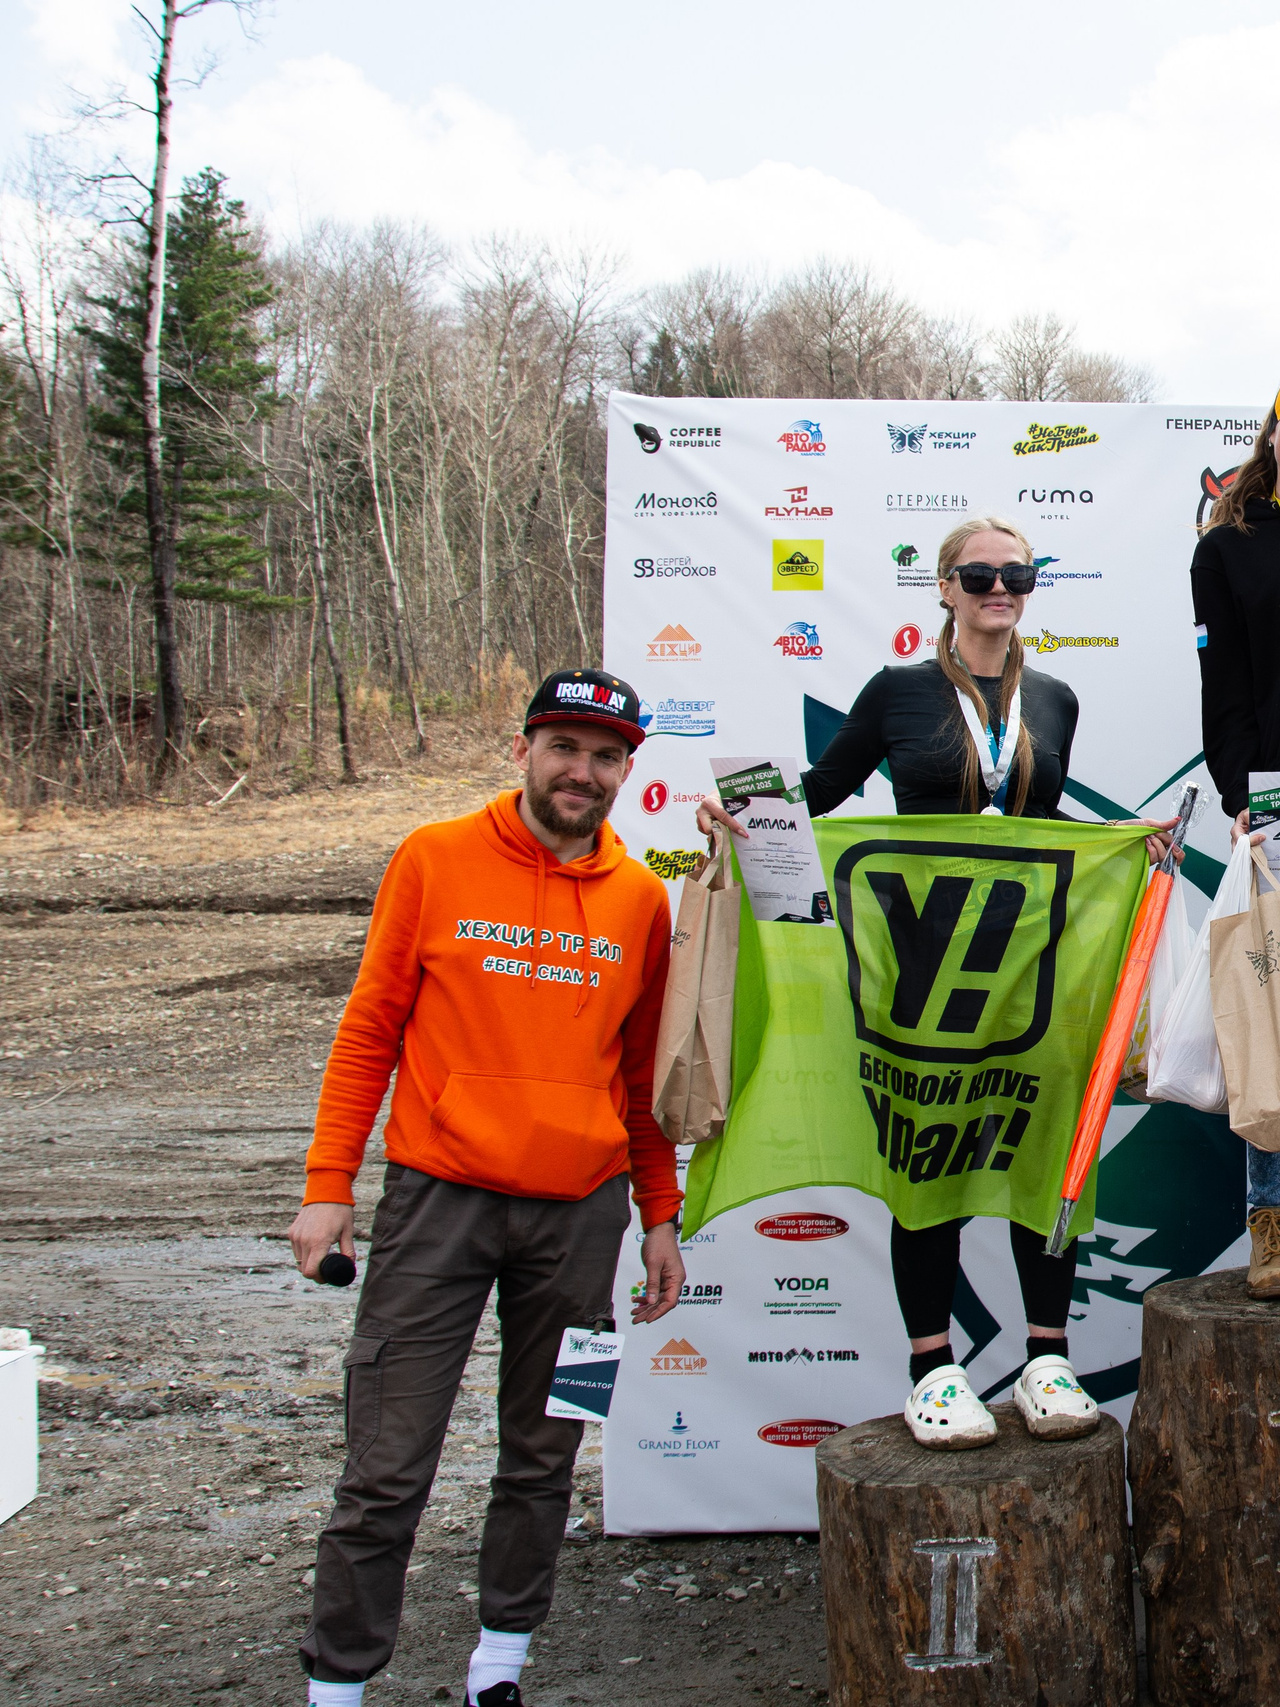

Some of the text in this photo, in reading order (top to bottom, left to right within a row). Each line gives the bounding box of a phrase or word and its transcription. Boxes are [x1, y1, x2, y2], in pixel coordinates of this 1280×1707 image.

[1166, 418, 1262, 430] ГЕНЕРАЛЬНЫ
[670, 427, 722, 437] COFFEE
[777, 432, 809, 443] АВТО
[929, 431, 977, 440] ХЕХЦИР
[669, 440, 722, 448] REPUBLIC
[786, 442, 826, 453] РАДИО
[886, 494, 968, 507] СТЕРЖЕНЬ
[765, 507, 834, 516] FLYHAB
[656, 556, 692, 566] СЕРГЕЙ
[656, 566, 717, 578] БОРОХОВ
[780, 565, 815, 573] ЭВЕРЕСТ
[1035, 571, 1103, 580] абаровский
[1035, 579, 1054, 588] рай
[773, 636, 806, 646] АВТО
[1059, 637, 1119, 648] ПОДВОРЬЕ
[782, 645, 823, 657] РАДИО
[556, 682, 627, 710] IRONWAY
[656, 699, 715, 712] АЙСБЕРГ
[754, 769, 780, 781] ХЕХЦИР
[756, 780, 773, 790] 2025
[747, 817, 798, 831] ДИПЛОМ
[455, 919, 622, 964] ХЕХЦИР ТРЕЙЛ
[859, 1051, 1041, 1107] БЕГОВОЙ КЛУБ
[763, 1227, 786, 1236] центр
[690, 1233, 717, 1243] LOAT
[774, 1278, 829, 1291] YODA
[693, 1285, 723, 1296] ДВА
[589, 1341, 618, 1350] ХЕХЦИР
[554, 1377, 613, 1390] ОРГАНИЗАТОР
[766, 1434, 789, 1442] центр
[638, 1439, 720, 1450] GRAND FLOAT
